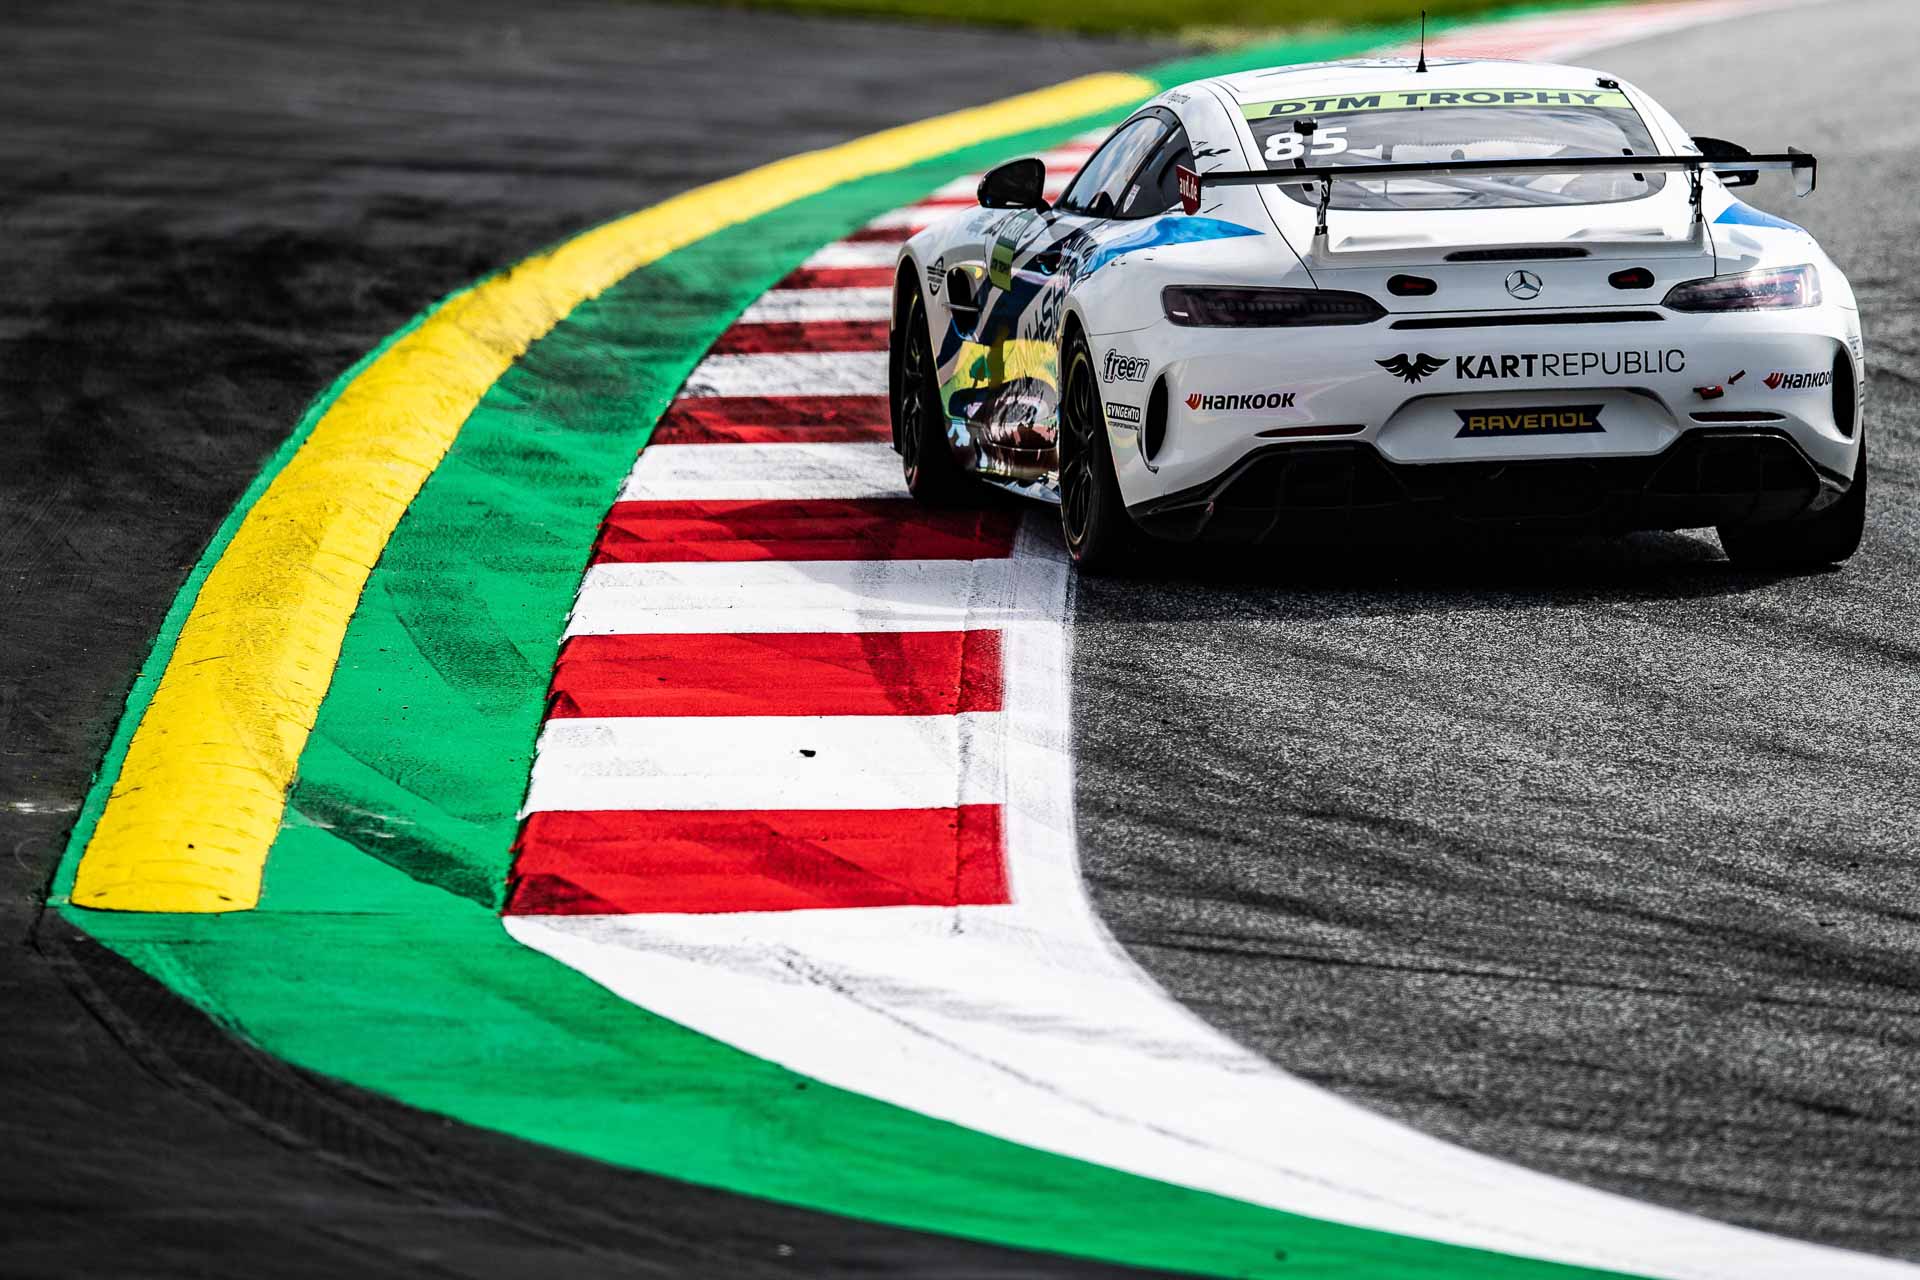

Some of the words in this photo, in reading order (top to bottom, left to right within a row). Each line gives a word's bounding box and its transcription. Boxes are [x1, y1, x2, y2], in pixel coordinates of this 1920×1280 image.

[1268, 95, 1381, 116] DTM
[1398, 91, 1603, 106] TROPHY
[1264, 126, 1348, 161] 85
[1104, 350, 1148, 381] freem
[1455, 349, 1685, 379] KARTREPUBLIC
[1469, 412, 1593, 431] RAVENOL
